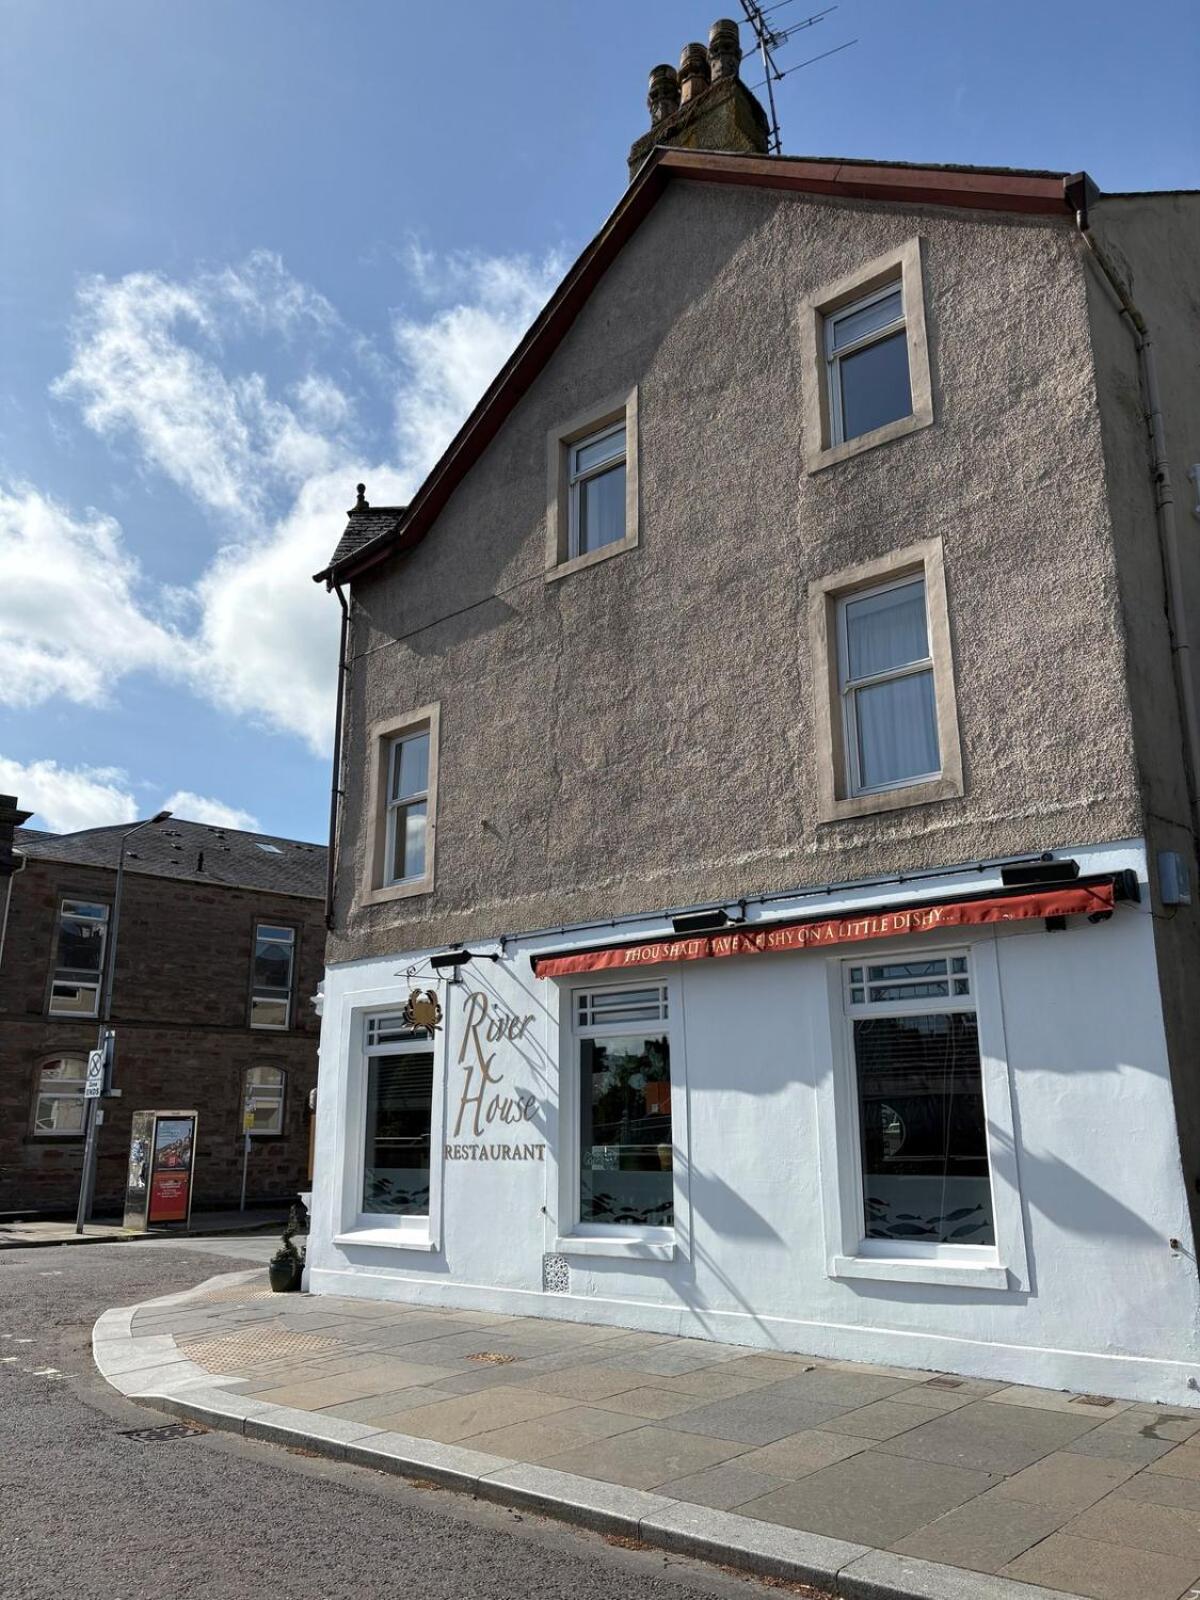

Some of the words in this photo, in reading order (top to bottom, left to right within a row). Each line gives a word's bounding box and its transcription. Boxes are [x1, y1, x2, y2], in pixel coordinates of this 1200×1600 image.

[624, 947, 660, 962] THOU
[662, 941, 700, 957] SHALT
[706, 935, 738, 953] HAVE
[742, 938, 751, 949] A
[798, 928, 820, 943] ON
[825, 925, 834, 939] A
[839, 917, 889, 937] LITTLE
[458, 991, 536, 1083] River
[453, 1053, 539, 1138] House
[444, 1143, 546, 1162] RESTAURANT
